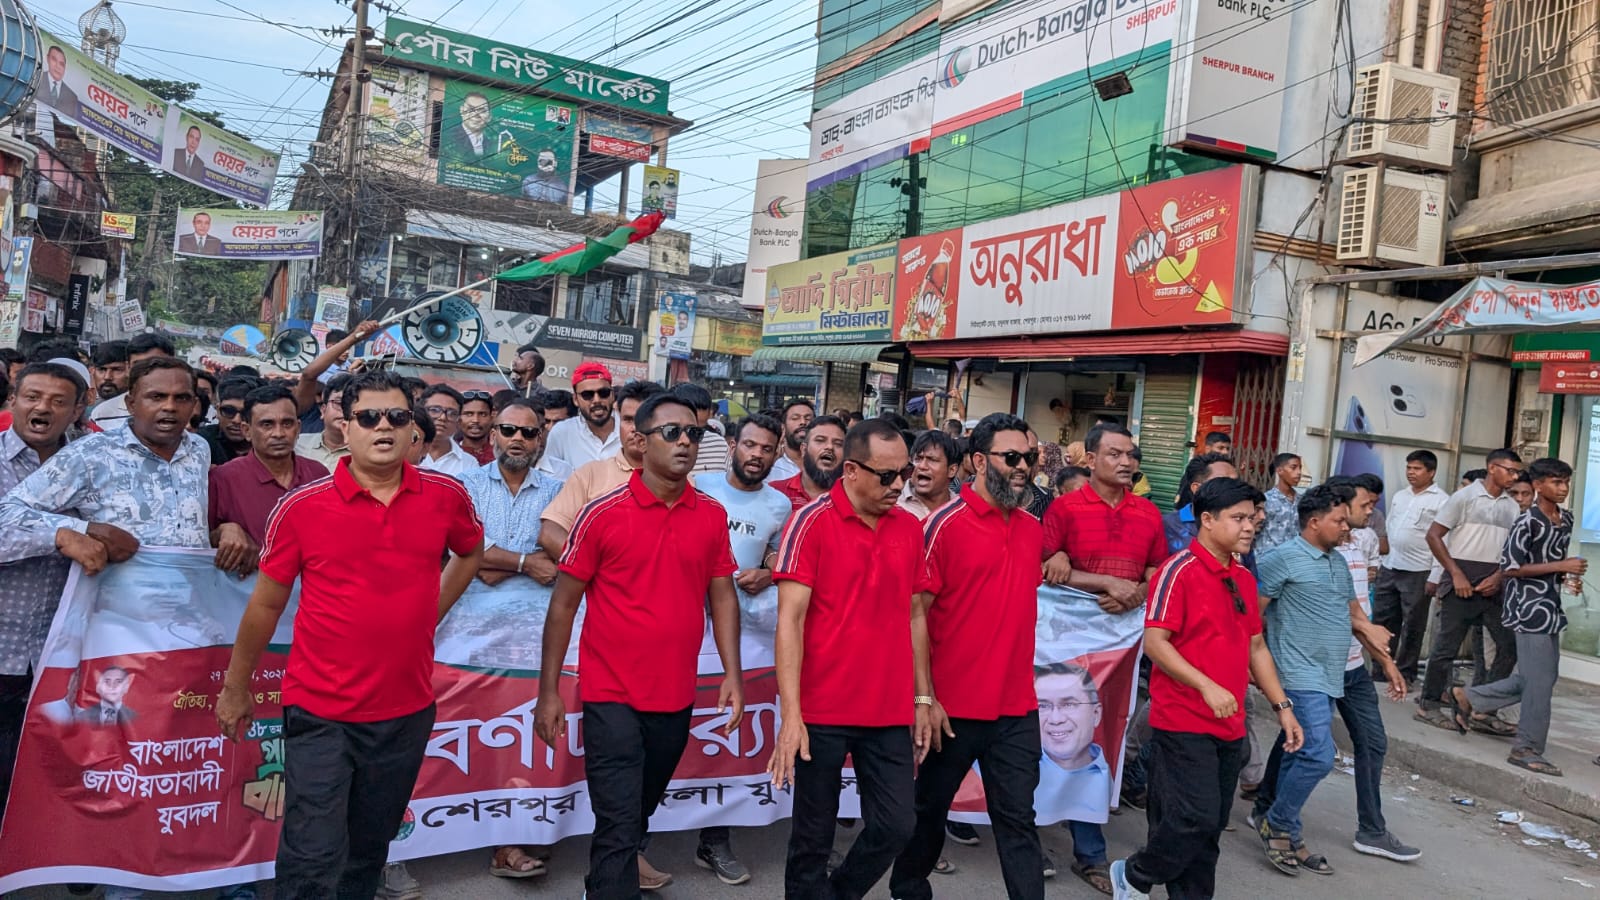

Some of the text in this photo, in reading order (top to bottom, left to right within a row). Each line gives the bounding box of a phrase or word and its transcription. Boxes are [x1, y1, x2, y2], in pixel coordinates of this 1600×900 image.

[1126, 0, 1176, 31] SHERPUR
[1250, 2, 1272, 20] PLC
[977, 0, 1107, 69] Dutch-Bangla
[395, 31, 661, 104] পৌর নিউ মার্কেট
[1202, 56, 1275, 82] SHERPUR BRANCH
[88, 84, 129, 119] মেয়র
[129, 111, 148, 130] পদে
[213, 151, 247, 174] মেয়র
[104, 214, 117, 225] KS
[232, 225, 300, 240] মেয়র পদে
[1173, 208, 1215, 234] বাংলাদেশের
[753, 228, 799, 238] Dutch-Bangla
[759, 239, 790, 247] Bank PLC
[1178, 225, 1218, 252] এক নম্বর
[969, 215, 1107, 307] অনুরাধা
[71, 283, 82, 311] Infinix
[781, 272, 825, 314] আদি
[1503, 284, 1542, 320] কিনুন
[125, 314, 142, 326] CHS
[820, 310, 890, 330] মিষ্টান্নালয়
[548, 324, 571, 337] SEVEN
[571, 327, 598, 340] MIRROR
[598, 332, 634, 345] COMPUTER
[1396, 352, 1417, 363] Power
[1425, 356, 1461, 369] Pro Smooth
[254, 692, 264, 704] ও
[127, 733, 228, 766] বাংলাদেশ
[82, 760, 225, 799] জাতীয়তাবাদী
[157, 801, 221, 835] যুবদল
[421, 791, 583, 828] শেরপুর
